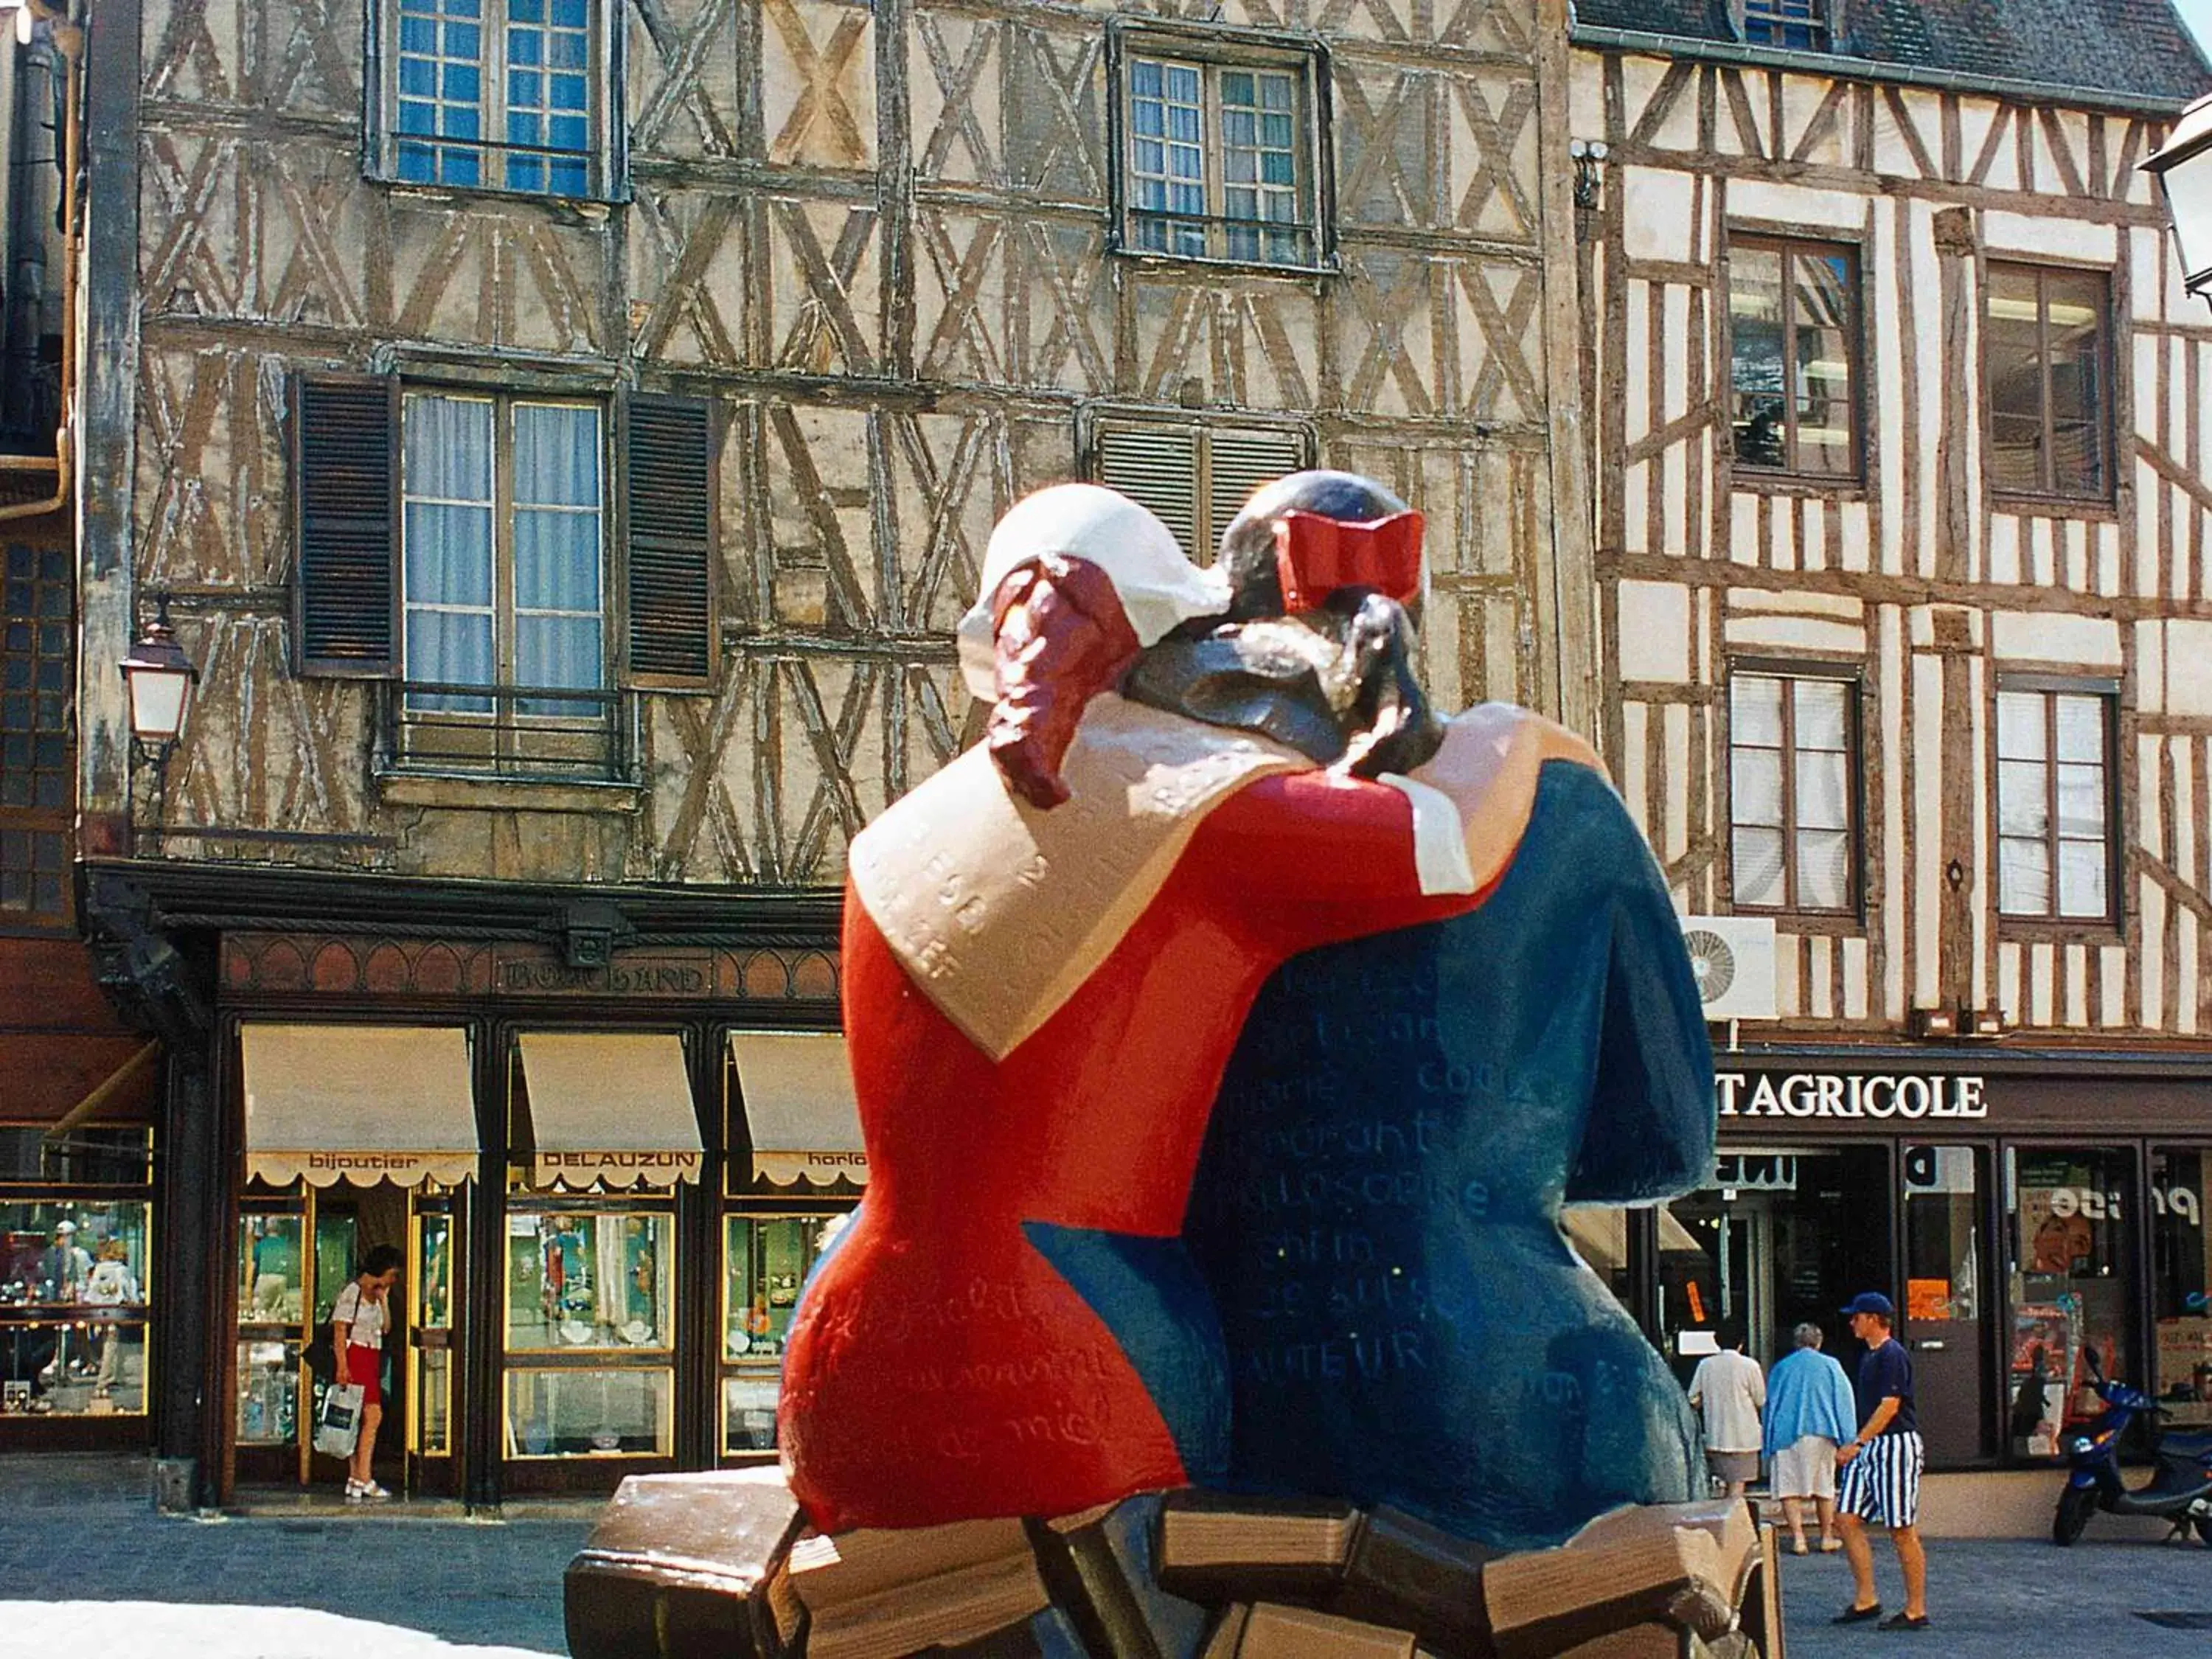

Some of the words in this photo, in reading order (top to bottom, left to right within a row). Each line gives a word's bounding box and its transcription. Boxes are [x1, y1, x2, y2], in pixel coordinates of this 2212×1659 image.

[1745, 1074, 1989, 1119] AGRICOLE
[309, 1152, 419, 1169] bijoutier
[544, 1152, 695, 1166] DELAUZUN
